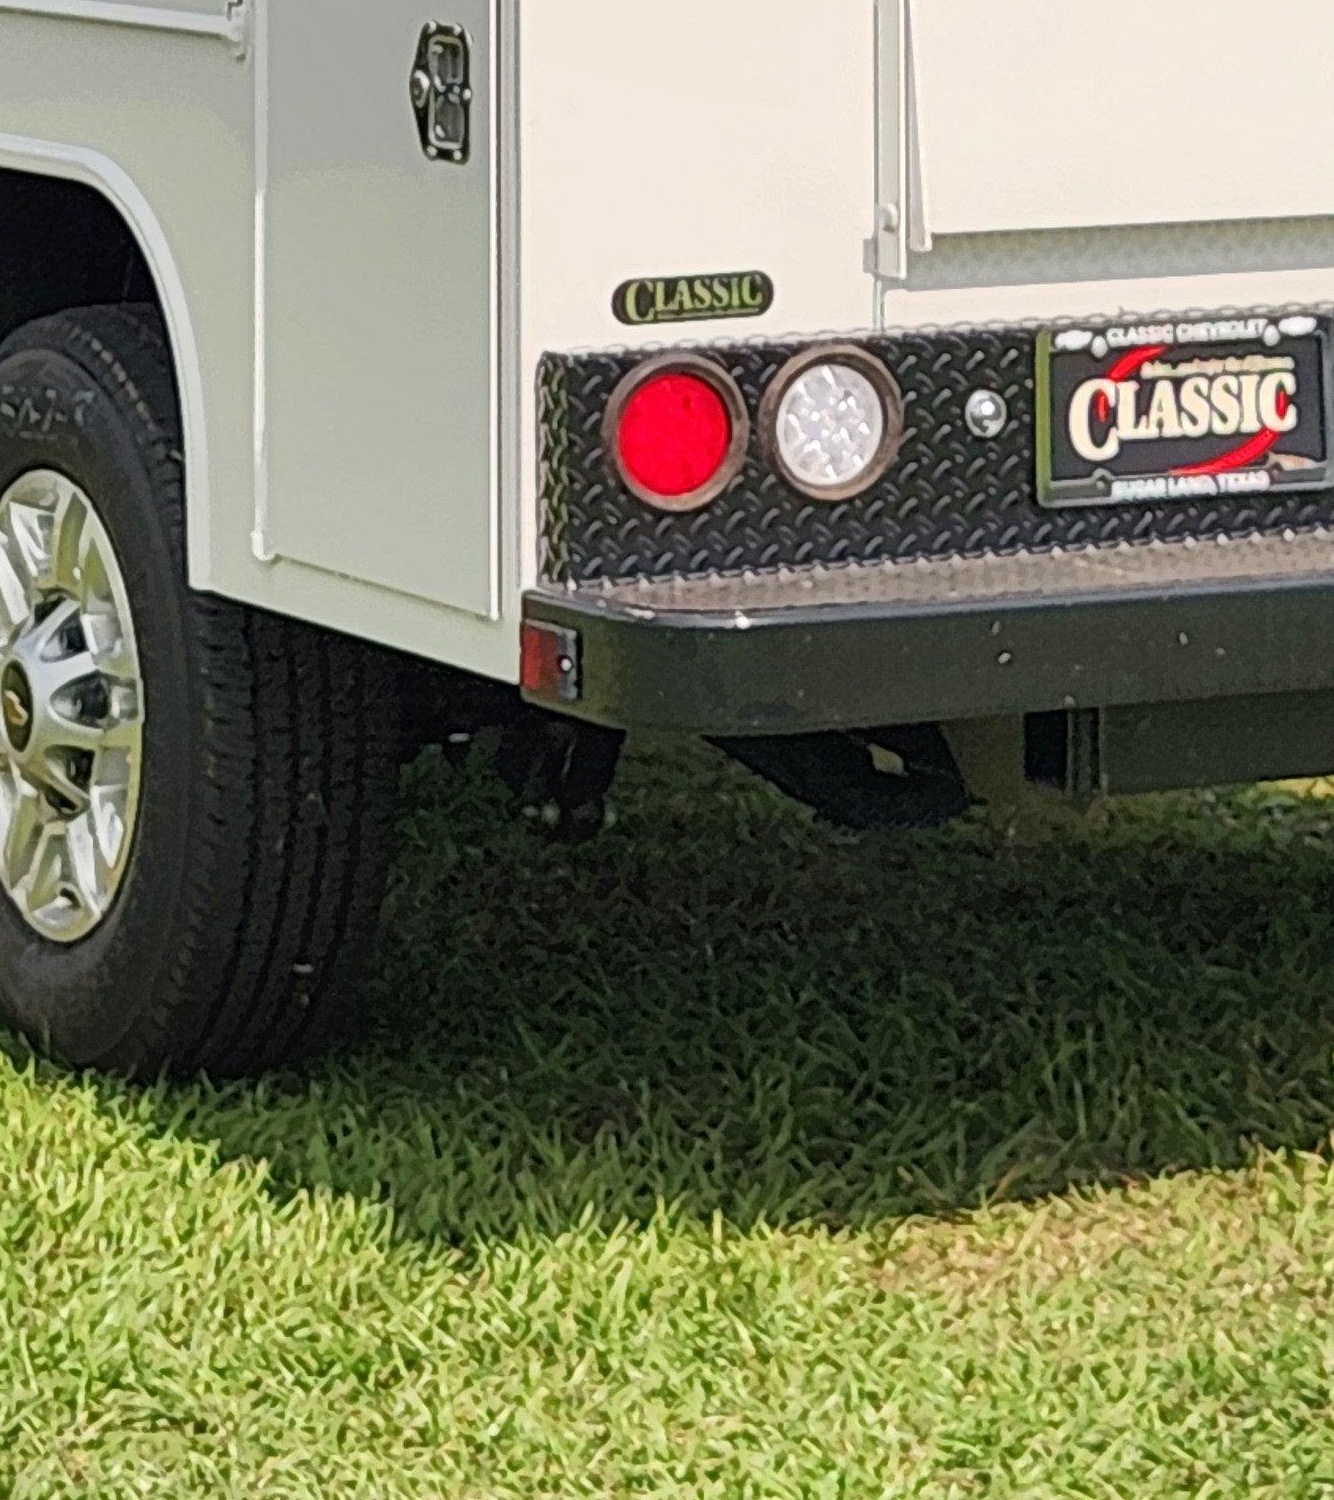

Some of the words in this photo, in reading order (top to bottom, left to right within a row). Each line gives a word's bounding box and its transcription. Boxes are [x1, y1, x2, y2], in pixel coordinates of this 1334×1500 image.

[624, 273, 765, 323] CLASSIC
[1106, 323, 1174, 347] CLASSIC
[1175, 318, 1268, 343] CHEVROLET
[1069, 372, 1298, 462] CLASSIC
[1216, 470, 1270, 494] TEXAS
